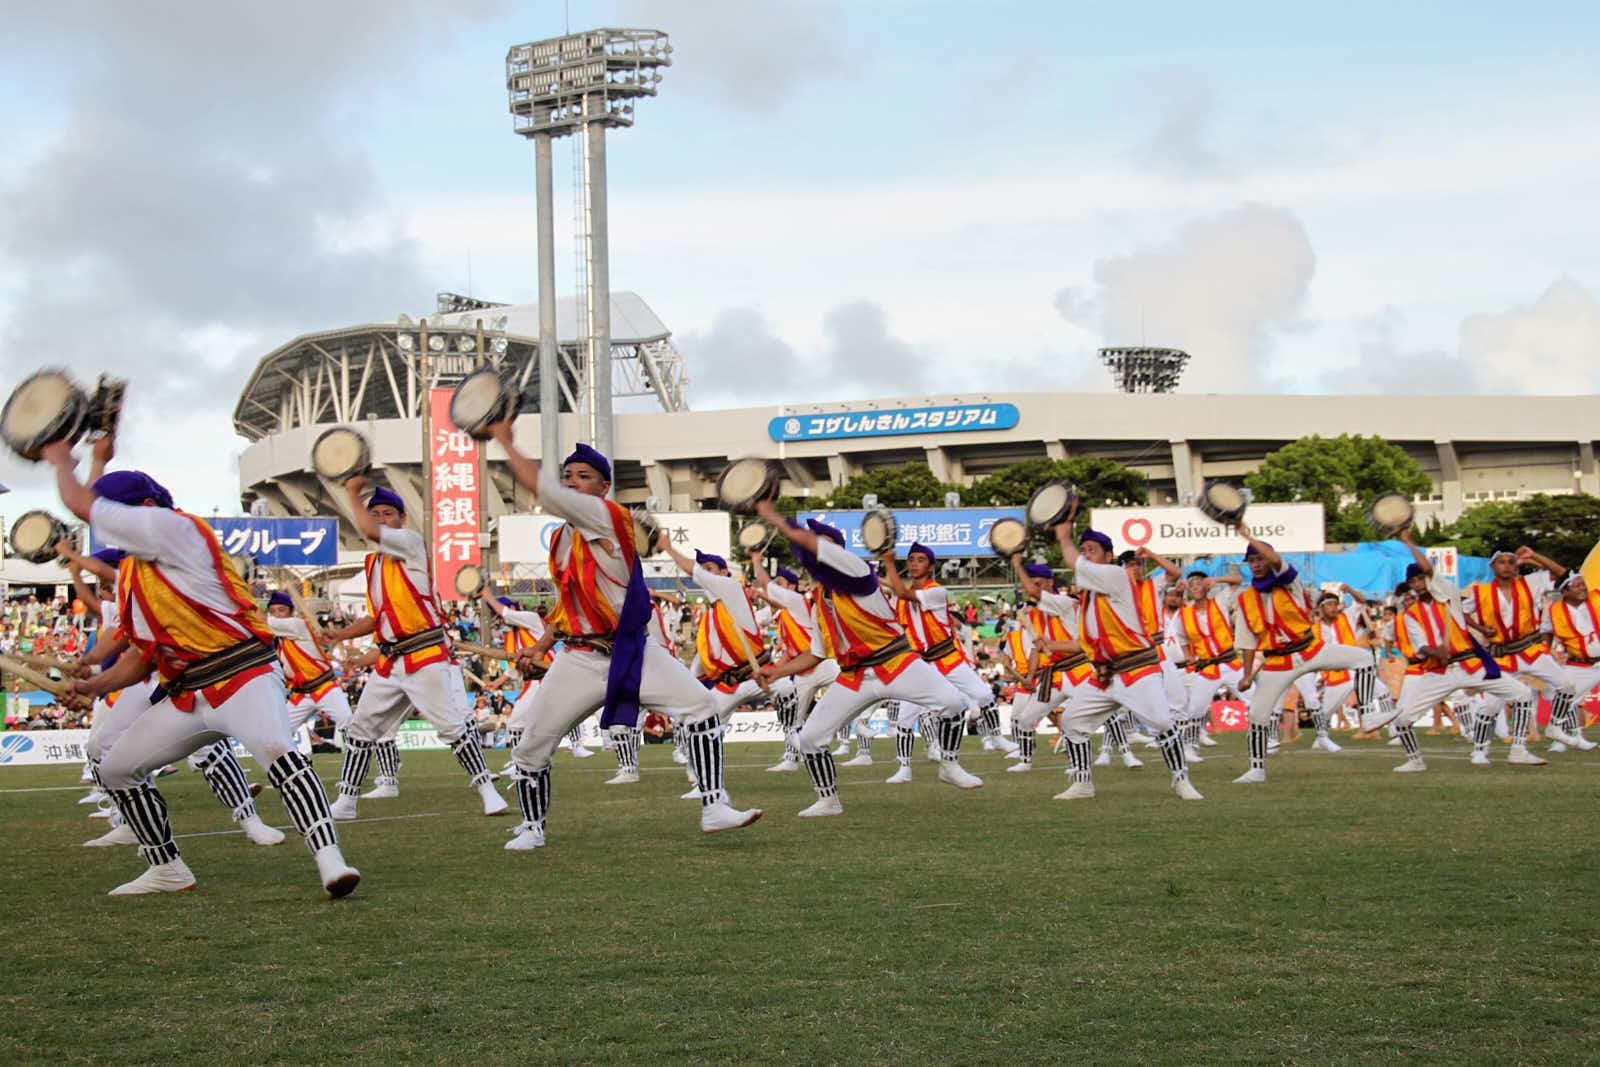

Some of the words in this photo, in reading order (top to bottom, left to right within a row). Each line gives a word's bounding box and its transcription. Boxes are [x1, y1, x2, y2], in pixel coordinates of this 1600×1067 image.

[808, 408, 997, 435] コザしんきんスタジアム
[436, 428, 476, 561] 沖縄銀行
[1160, 522, 1220, 538] Daiwa
